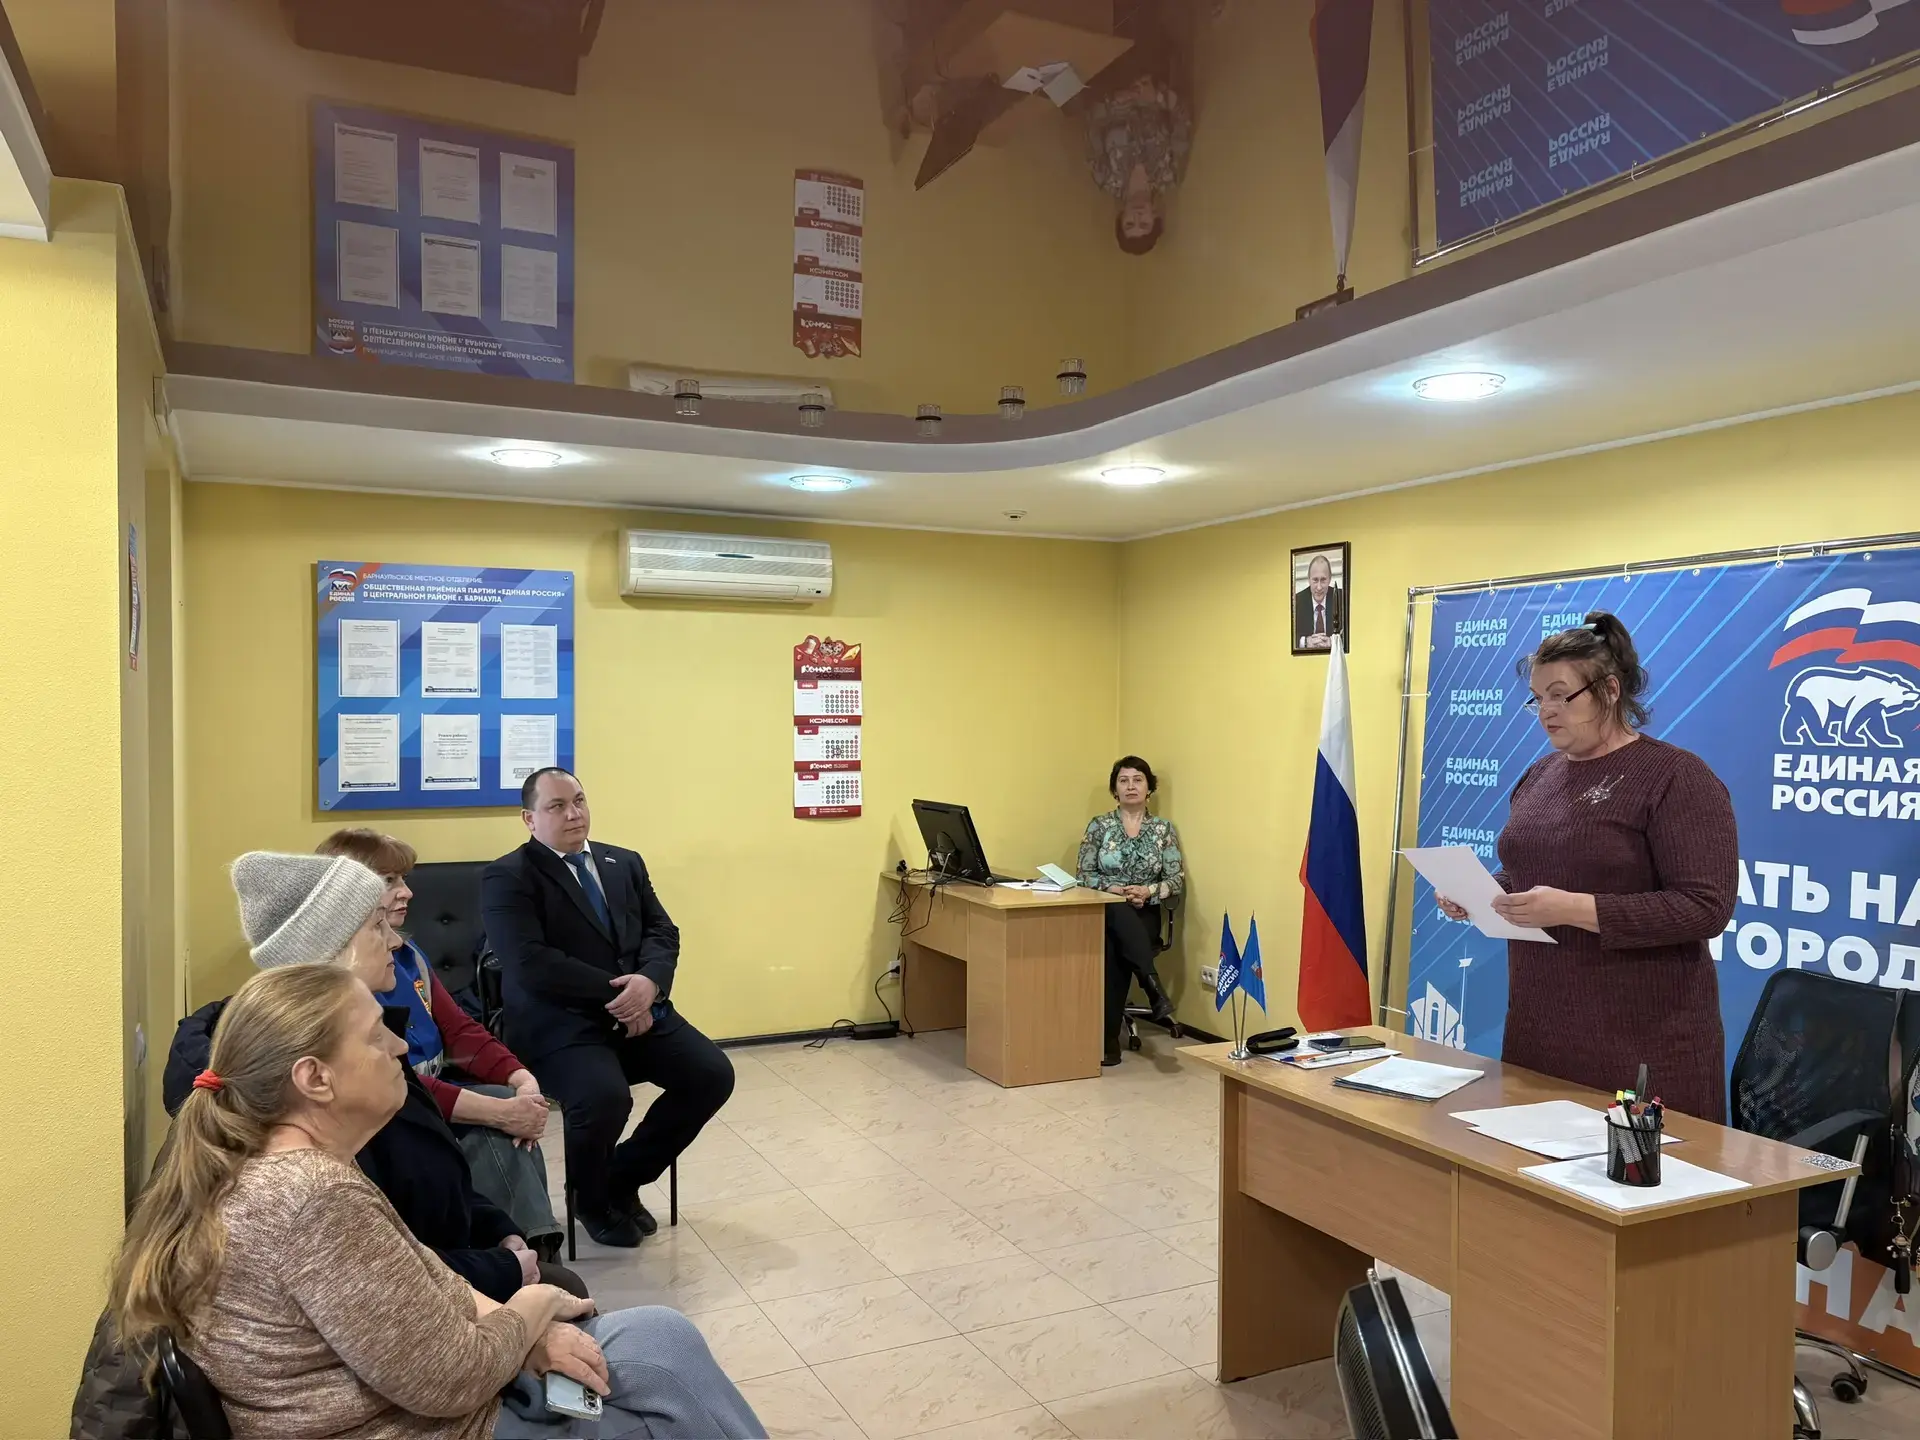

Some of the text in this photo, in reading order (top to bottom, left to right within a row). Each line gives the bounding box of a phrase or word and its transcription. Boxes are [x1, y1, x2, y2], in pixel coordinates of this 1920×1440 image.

[362, 572, 483, 583] БАРНАУЛЬСКОЕ МЕСТНОЕ ОТДЕЛЕНИЕ
[363, 583, 425, 593] ОБЩЕСТВЕННАЯ
[427, 585, 466, 594] ПРИЁМНАЯ
[468, 587, 496, 595] ПАРТИИ
[370, 591, 426, 600] ЦЕНТРАЛЬНОМ
[428, 592, 457, 601] РАЙОНЕ
[465, 594, 502, 603] БАРНАУЛА
[1455, 618, 1508, 634] ЕДИНАЯ
[1454, 632, 1507, 648] РОССИЯ
[1450, 689, 1503, 702] ЕДИНАЯ
[1449, 703, 1502, 716] РОССИЯ
[1446, 757, 1499, 772] ЕДИНАЯ
[1772, 753, 1920, 784] ЕДИНАЯ
[1445, 771, 1498, 787] РОССИЯ
[1772, 784, 1920, 821] РОССИЯ
[1441, 825, 1494, 843] ЕДИНАЯ
